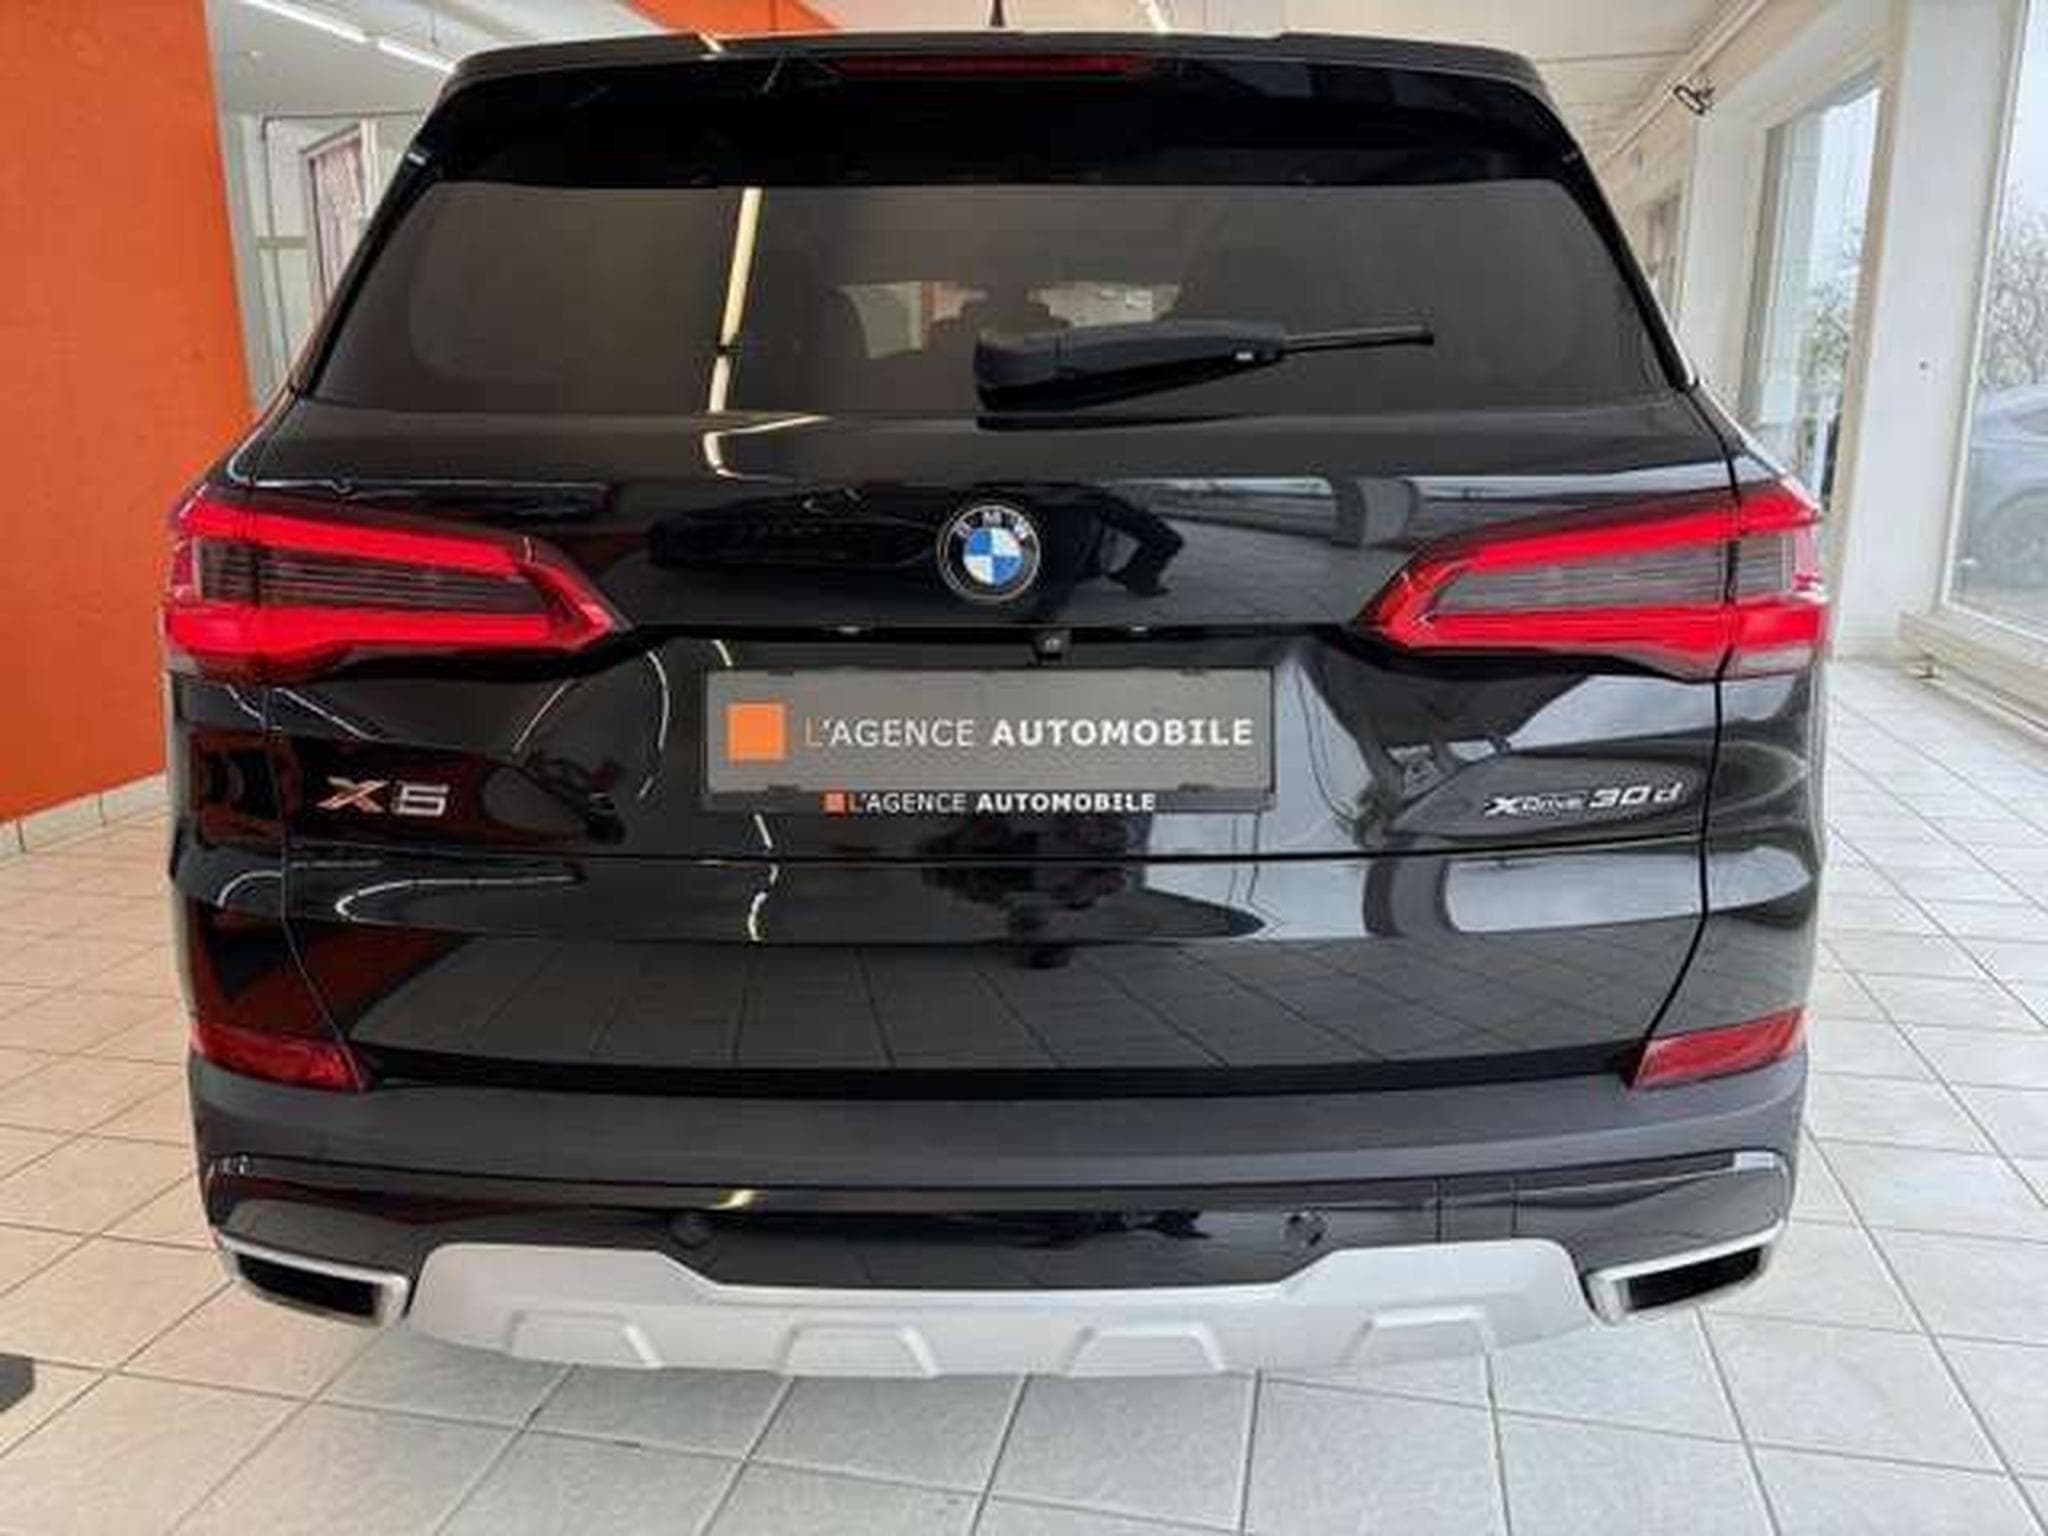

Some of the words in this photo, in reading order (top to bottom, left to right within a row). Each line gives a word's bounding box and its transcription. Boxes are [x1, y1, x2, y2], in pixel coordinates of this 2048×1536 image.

[805, 717, 975, 747] L'AGENCE
[991, 718, 1254, 747] AUTOMOBILE
[316, 776, 449, 817] X5
[850, 792, 967, 813] L'AGENCE
[975, 792, 1157, 813] AUTOMOBILE
